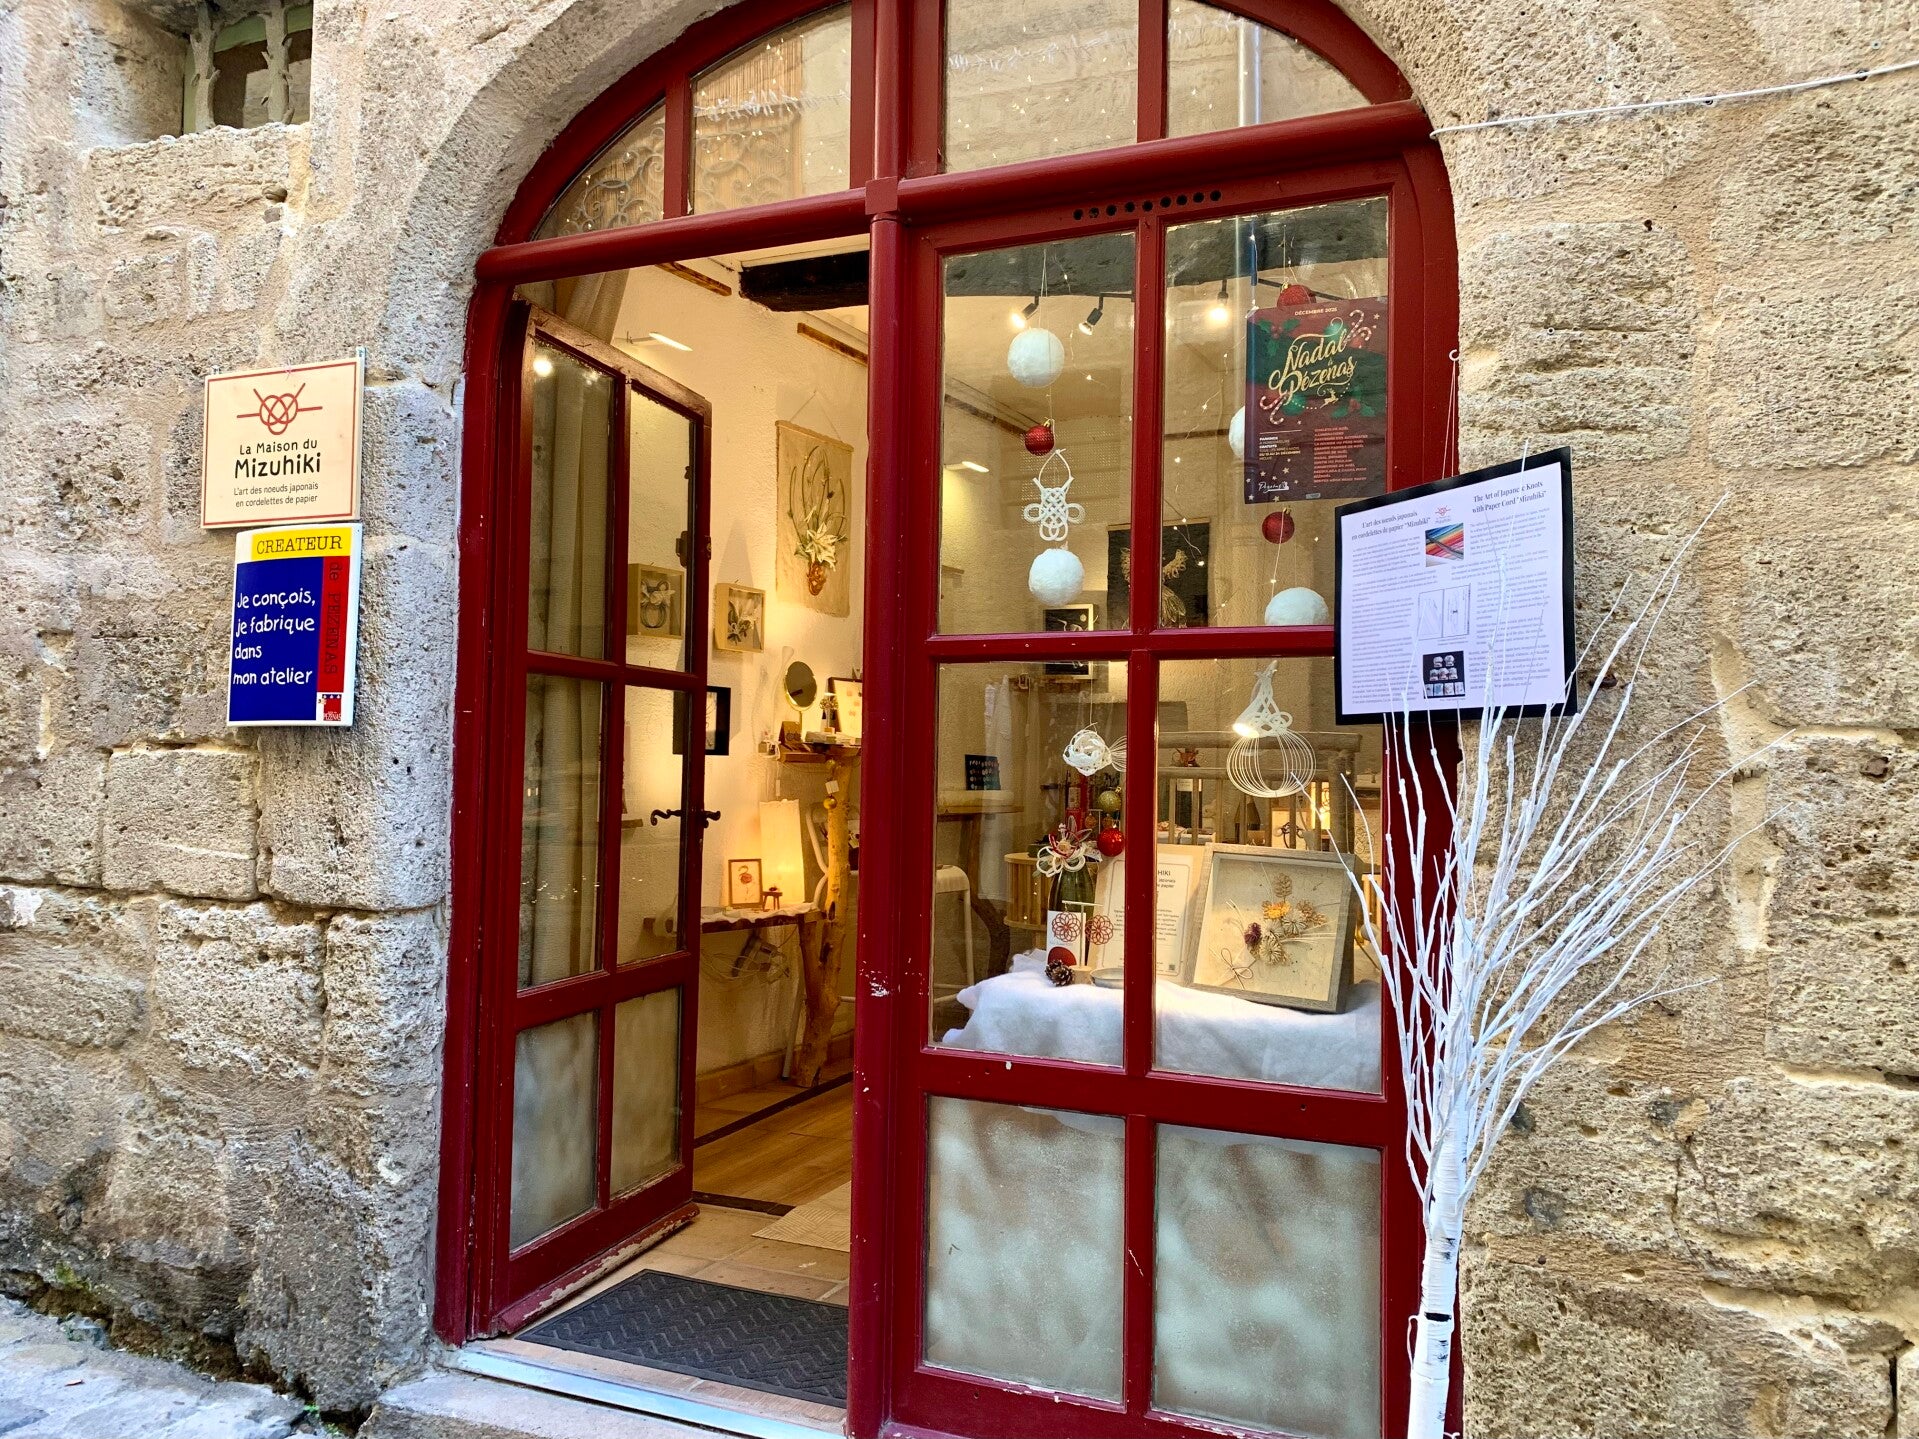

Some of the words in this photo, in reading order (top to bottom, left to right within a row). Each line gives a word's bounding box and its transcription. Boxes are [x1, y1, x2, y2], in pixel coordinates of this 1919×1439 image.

[1283, 328, 1347, 373] Nadal
[1278, 356, 1357, 403] Pézenas
[240, 444, 251, 455] La
[256, 441, 298, 454] Maison
[303, 439, 318, 449] du
[235, 452, 321, 478] Mizuhiki
[250, 486, 262, 494] des
[289, 482, 318, 494] japonais
[1500, 486, 1525, 497] Japanee
[1526, 482, 1543, 490] Knots
[245, 497, 283, 507] cordelettes
[285, 496, 294, 504] de
[296, 494, 318, 504] papier
[1472, 505, 1484, 513] with
[1485, 502, 1500, 511] Paper
[1502, 497, 1516, 506] Cord
[257, 535, 342, 554] CREATEUR
[237, 593, 250, 609] Je
[252, 588, 315, 609] conçois,
[236, 618, 247, 637] je
[250, 614, 315, 634] fabrique
[235, 643, 262, 660] dans
[233, 671, 257, 685] mon
[261, 667, 312, 685] atelier
